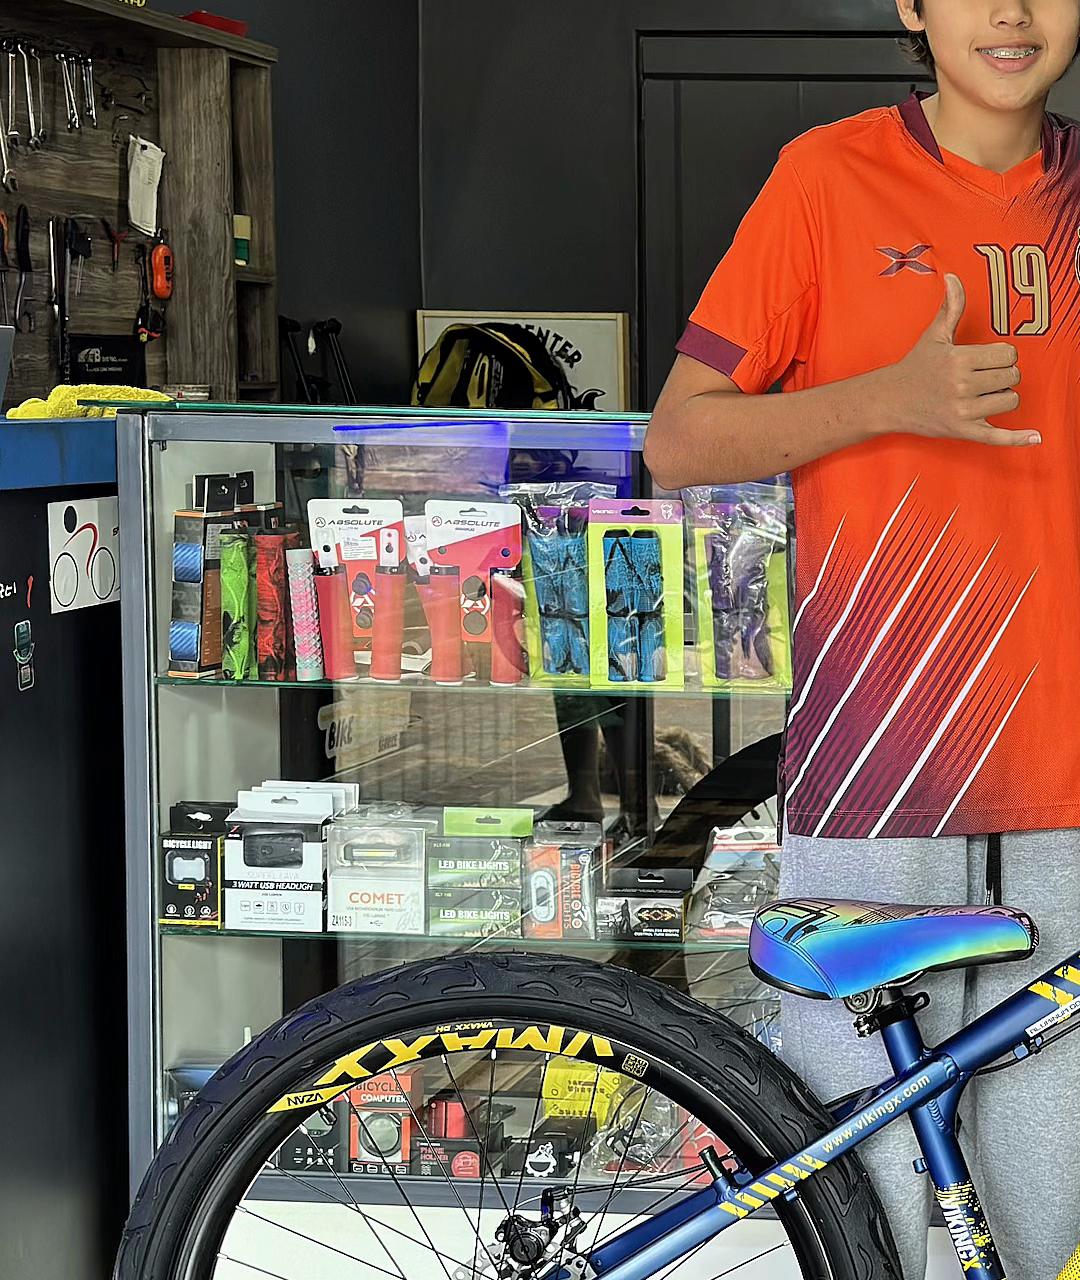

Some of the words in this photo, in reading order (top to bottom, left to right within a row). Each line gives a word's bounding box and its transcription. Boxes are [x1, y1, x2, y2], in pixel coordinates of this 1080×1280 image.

[973, 244, 1050, 336] 19
[514, 323, 583, 369] ENTER
[327, 519, 384, 527] ABSOLUTE
[444, 519, 501, 528] ABSOLUTE
[438, 859, 455, 870] LED
[457, 860, 478, 870] BIKE
[479, 861, 509, 871] LIGHTS
[349, 892, 405, 905] COMET
[440, 909, 456, 919] LED
[458, 909, 478, 919] BIKE
[479, 910, 510, 921] LIGHTS
[454, 1021, 494, 1031] VMAXX
[312, 1024, 614, 1087] VMAXX
[822, 1074, 931, 1154] www.vikingx.com
